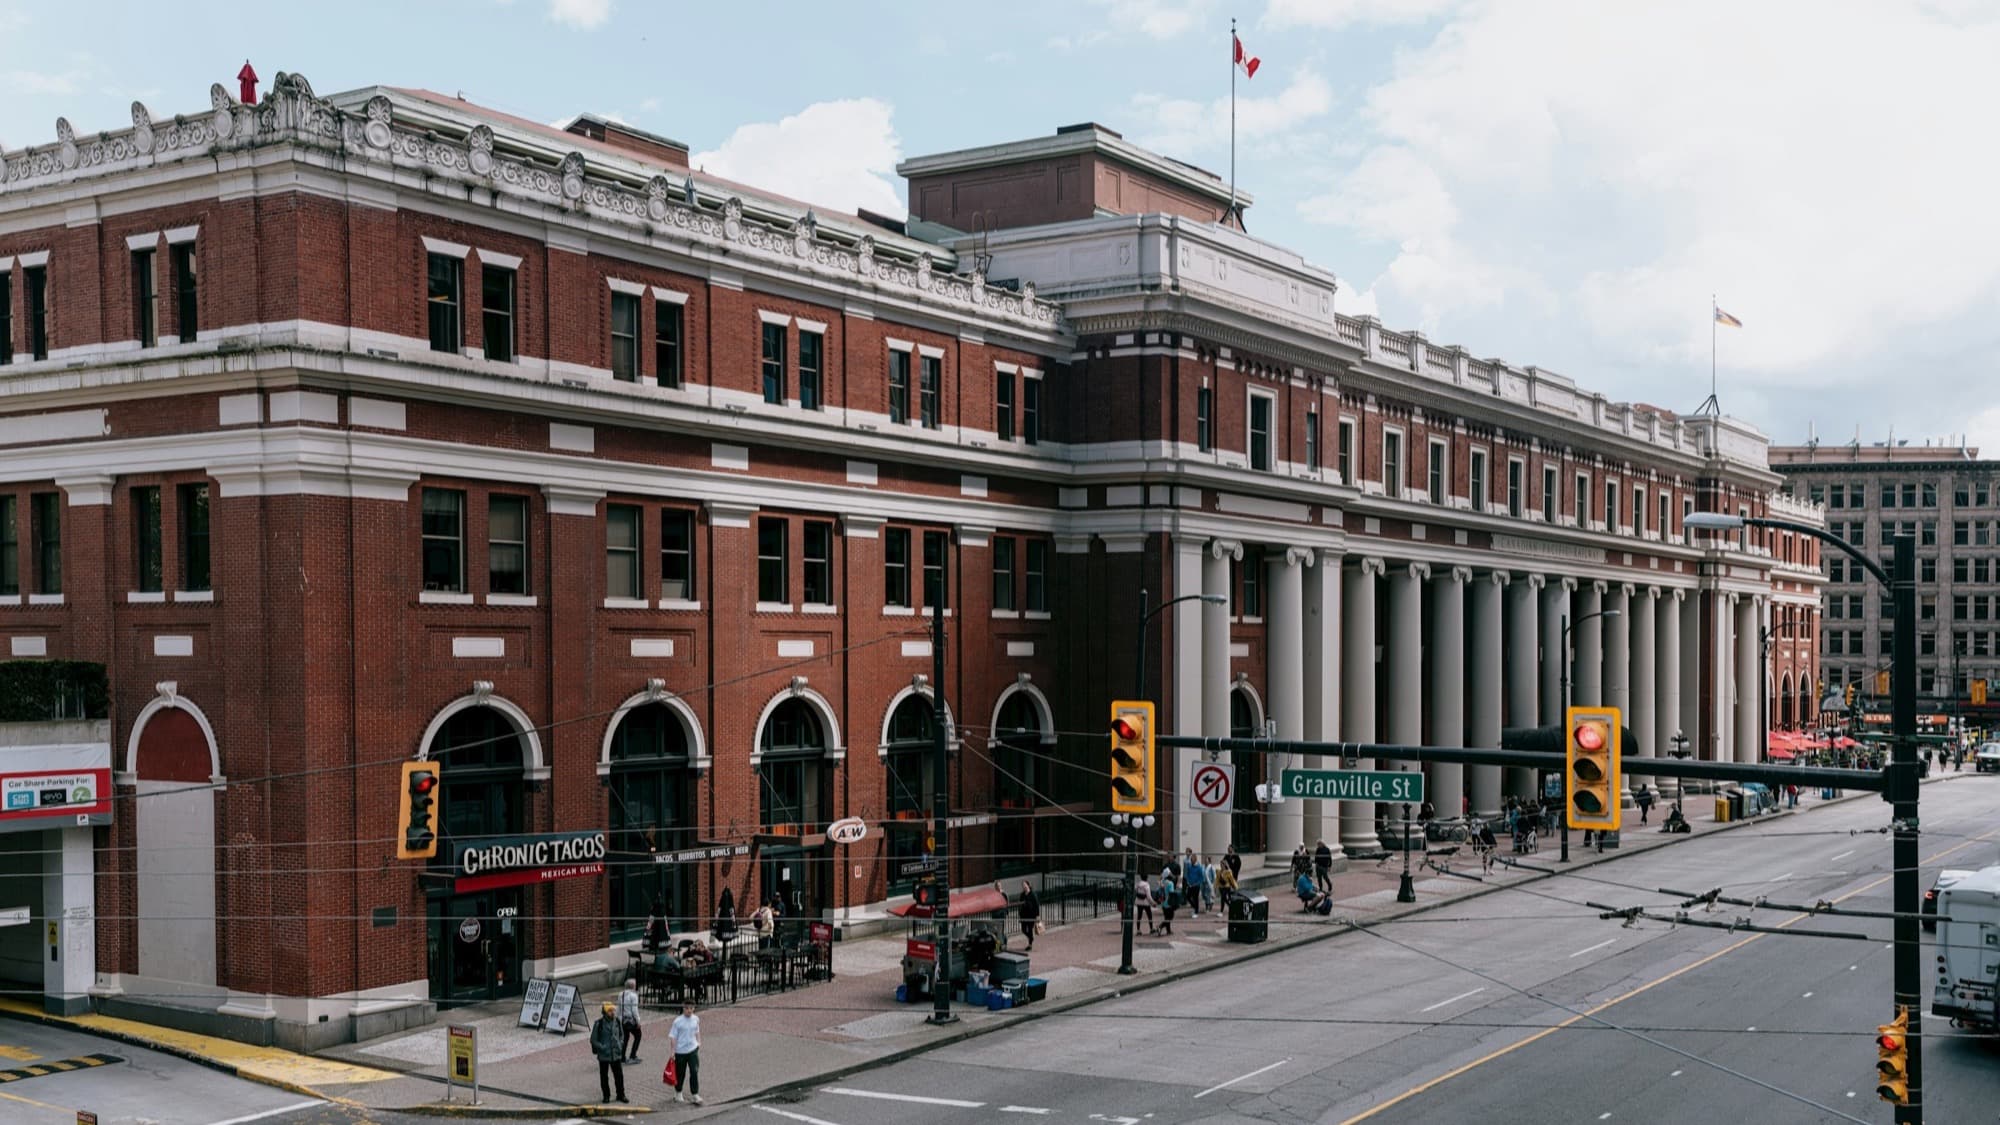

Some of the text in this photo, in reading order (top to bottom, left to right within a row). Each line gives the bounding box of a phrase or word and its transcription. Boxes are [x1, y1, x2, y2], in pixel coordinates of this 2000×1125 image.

[24, 779, 45, 787] Share
[47, 777, 74, 786] Parking
[1293, 775, 1410, 798] Granville St
[464, 834, 605, 875] CHRONIC TACOS
[656, 846, 749, 863] TACOS BURRITOS BOWLS BEER
[541, 866, 603, 879] MEXICAN GRILL
[497, 907, 517, 918] OPEN
[529, 981, 548, 993] HAPPY
[527, 990, 545, 1001] HOUR
